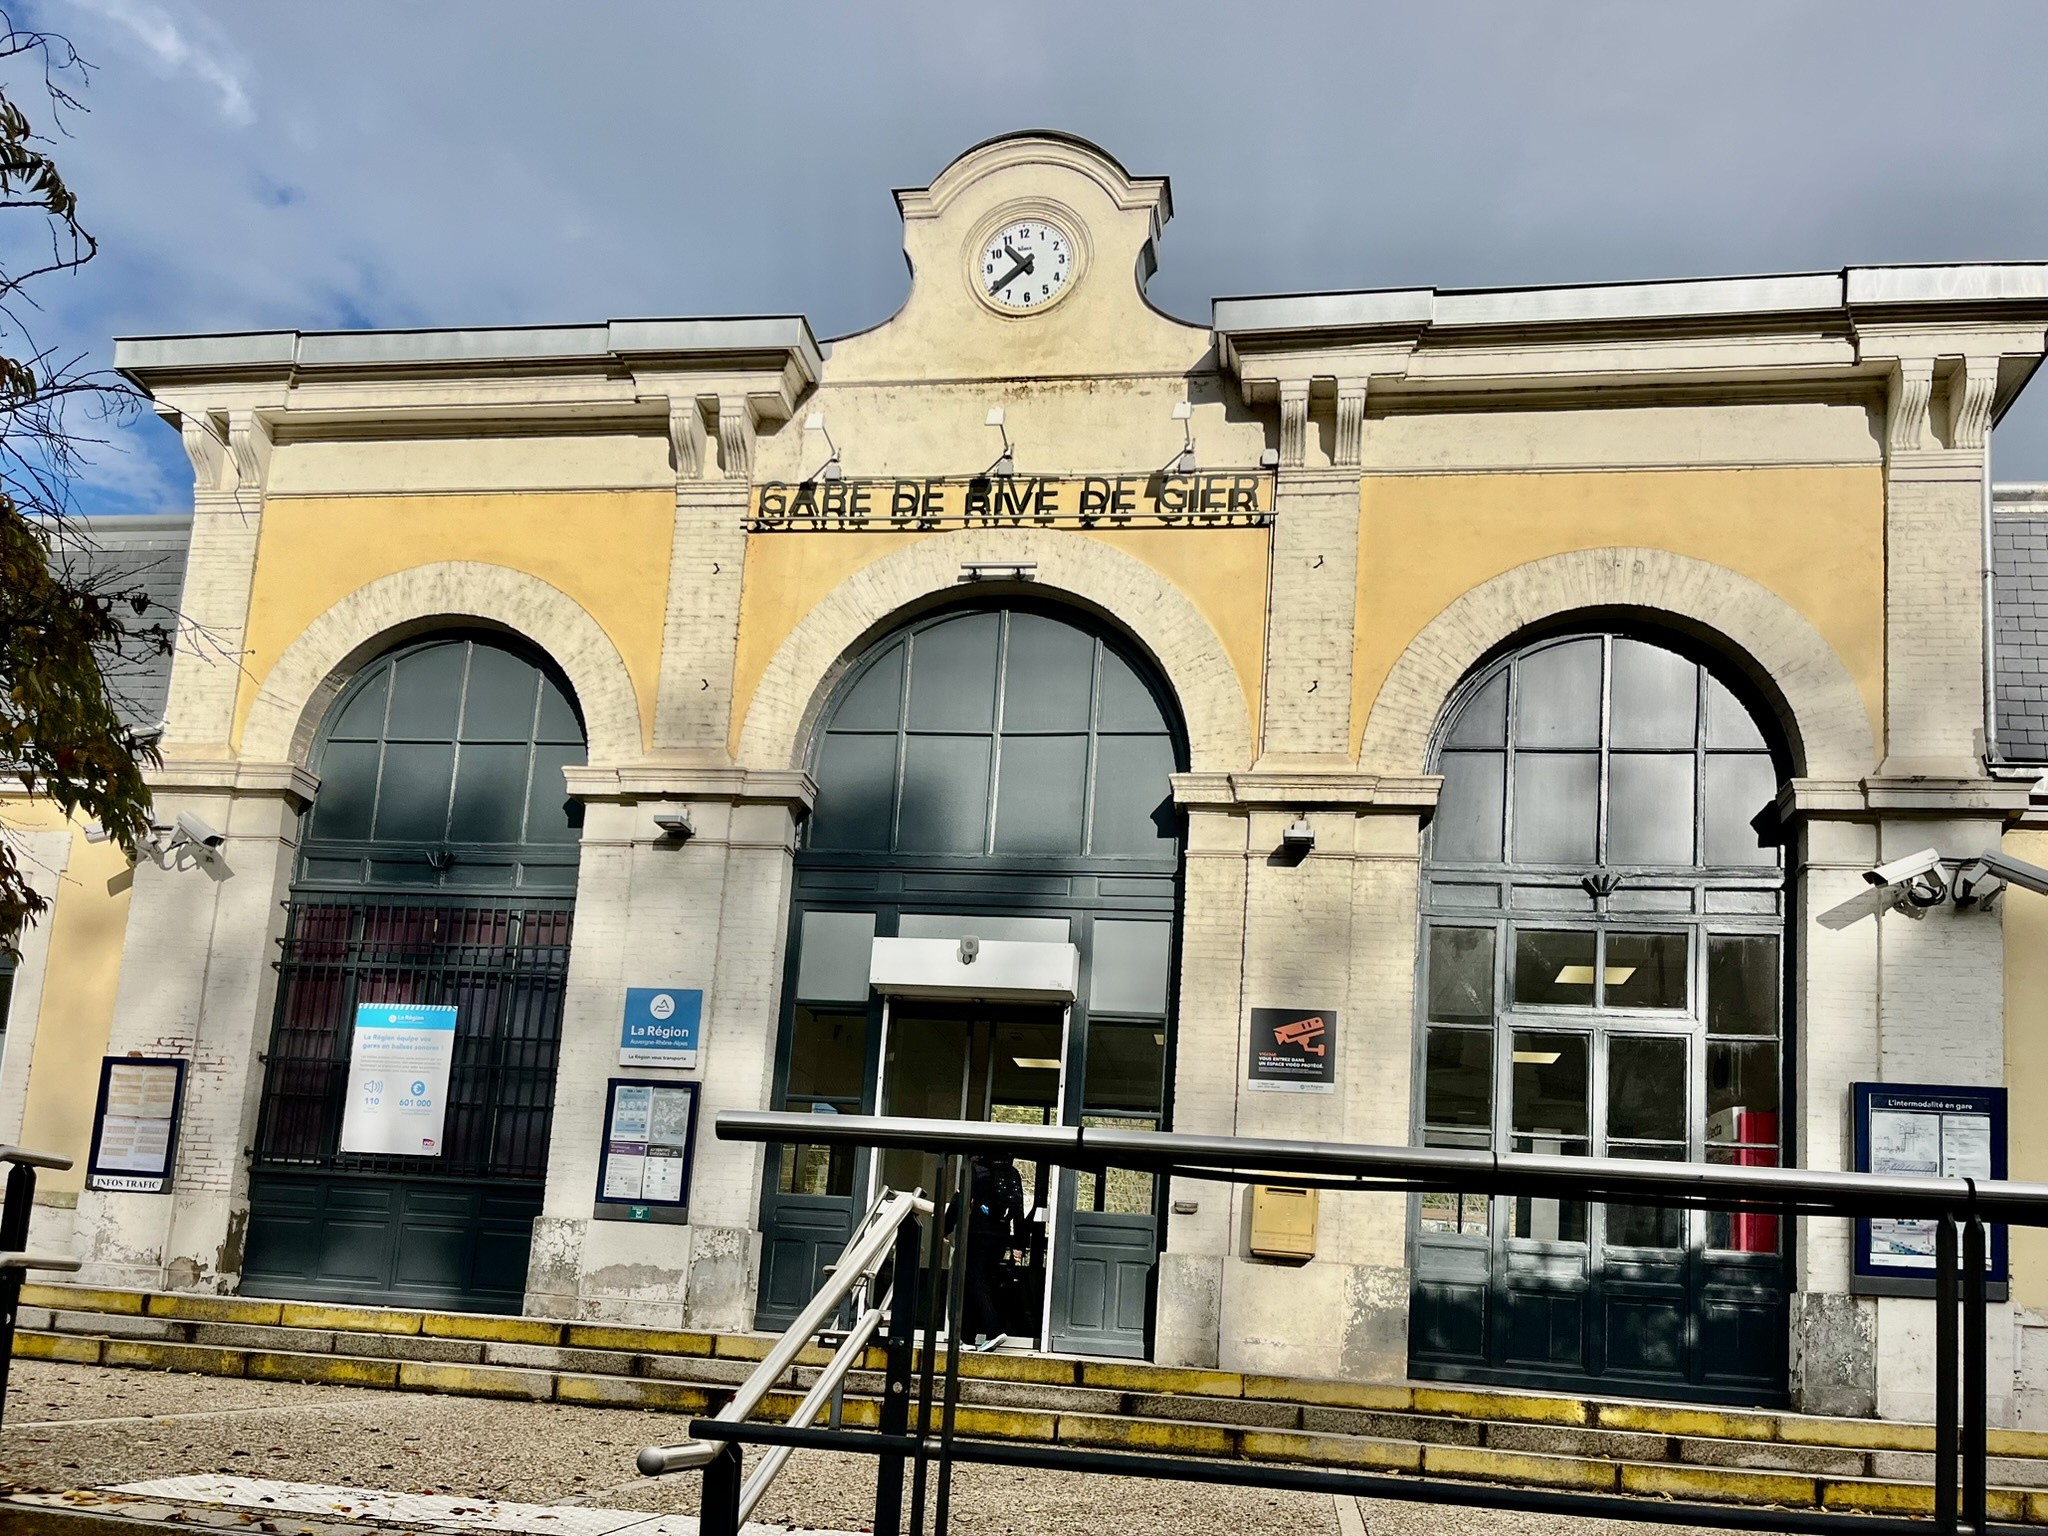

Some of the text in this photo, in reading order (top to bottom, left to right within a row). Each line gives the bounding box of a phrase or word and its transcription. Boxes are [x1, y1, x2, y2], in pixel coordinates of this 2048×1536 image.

[1019, 228, 1030, 239] 12
[1040, 231, 1045, 241] 1
[1003, 235, 1012, 245] 11
[1053, 241, 1059, 251] 2
[991, 249, 1002, 259] 10
[1058, 254, 1065, 264] 3
[986, 264, 993, 274] 9
[1054, 272, 1060, 282] 4
[1006, 289, 1012, 300] 7
[1042, 284, 1049, 295] 5
[1023, 292, 1030, 302] 6
[760, 474, 1260, 514] GARE DE RIVE DE GIER
[631, 1025, 689, 1039] La Région
[365, 1097, 380, 1105] 110
[1888, 1099, 1943, 1108] L'intermodalité
[1956, 1103, 1973, 1111] gare
[97, 1178, 158, 1189] INFOS TRAFIC
